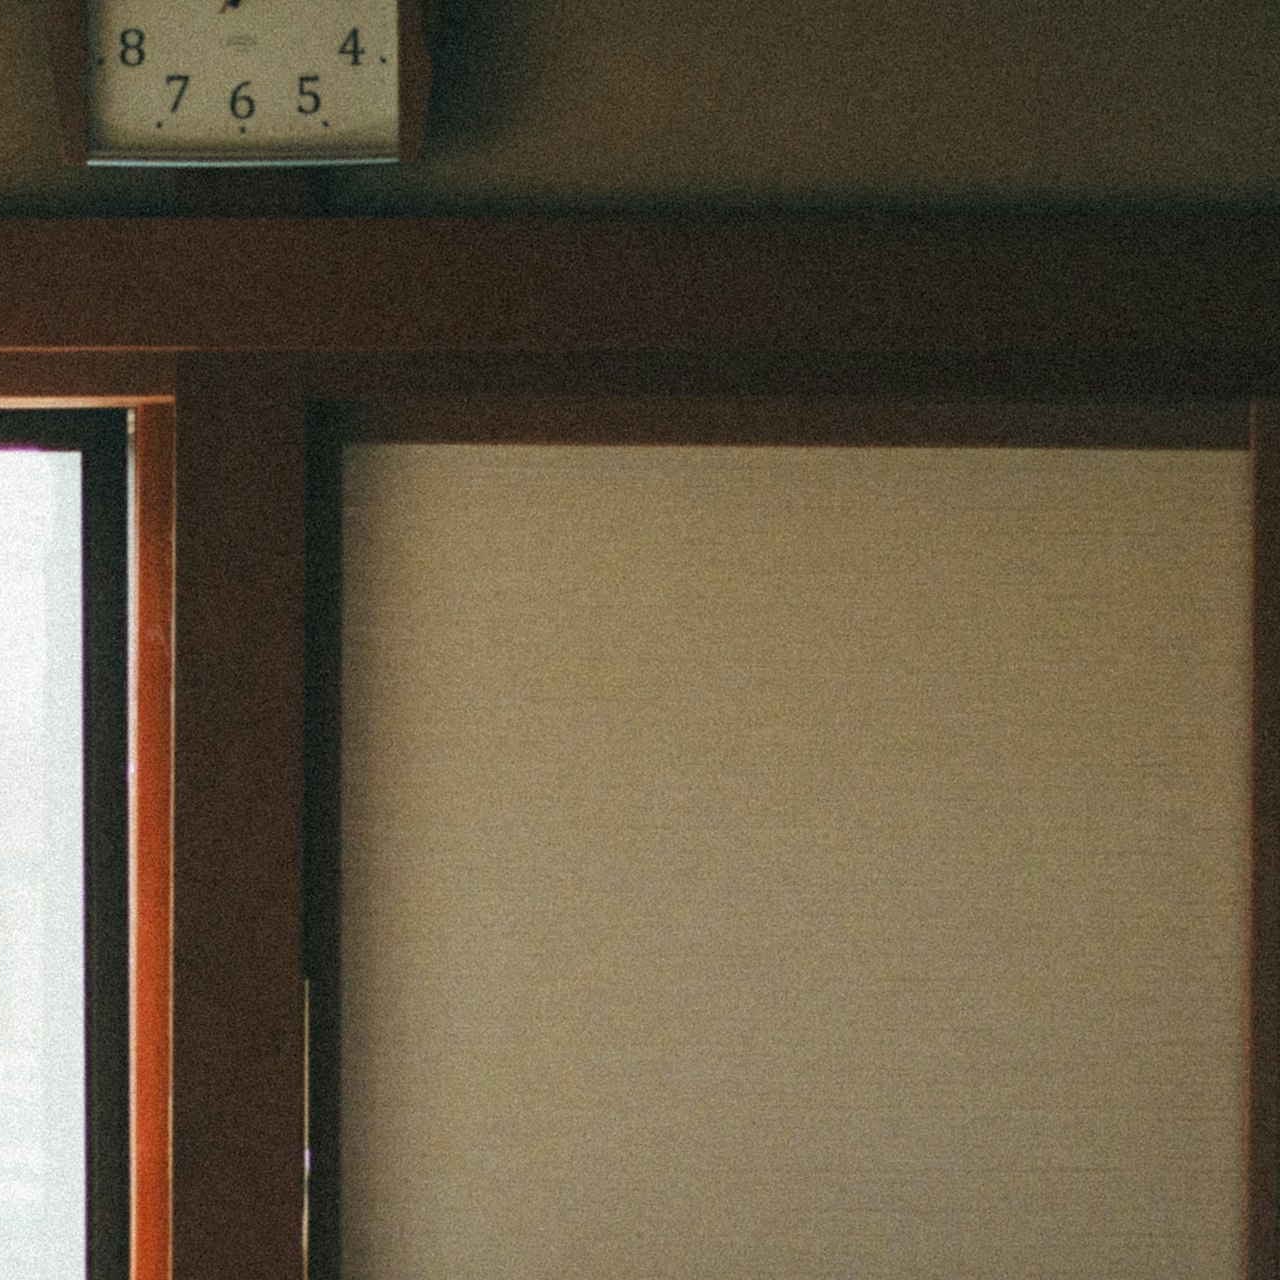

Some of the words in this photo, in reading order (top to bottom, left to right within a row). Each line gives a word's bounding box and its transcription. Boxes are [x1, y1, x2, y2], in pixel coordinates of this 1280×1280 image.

[119, 28, 146, 67] 8
[338, 27, 365, 67] 4
[165, 74, 190, 113] 7
[229, 81, 256, 119] 6
[297, 74, 322, 115] 5
